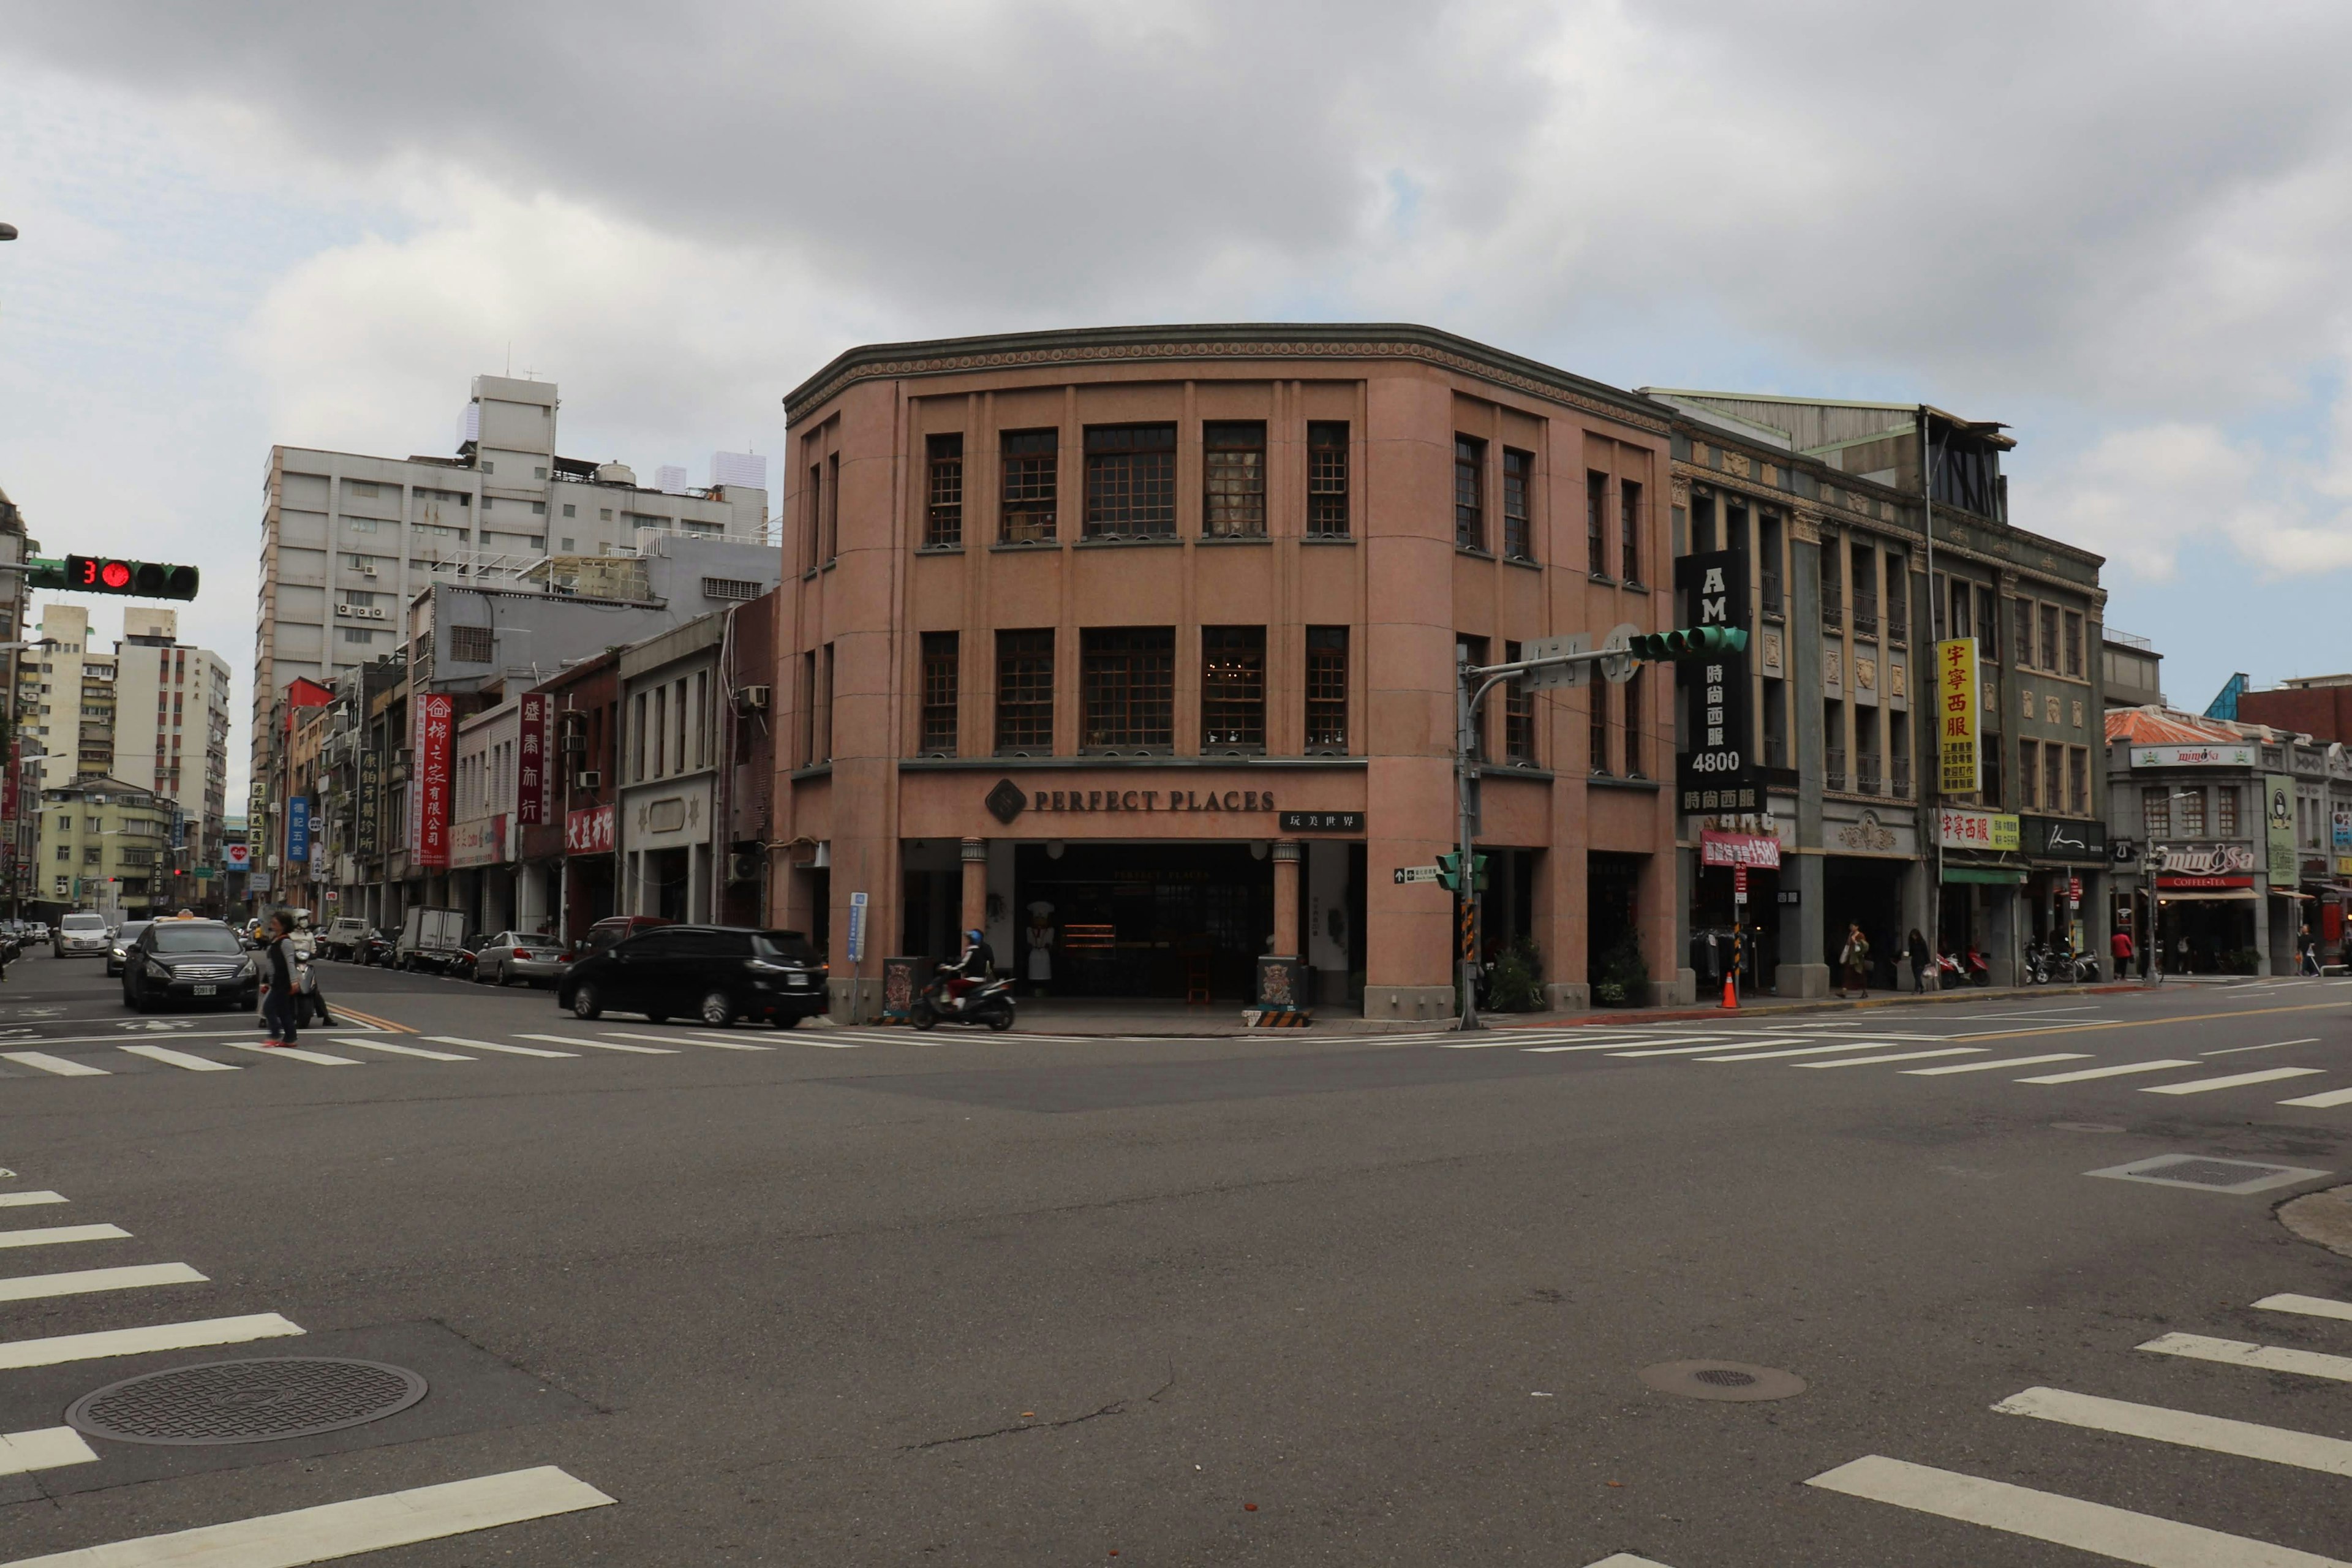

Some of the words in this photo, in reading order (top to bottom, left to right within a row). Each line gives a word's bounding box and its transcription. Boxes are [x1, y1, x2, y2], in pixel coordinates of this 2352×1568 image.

[84, 560, 96, 584] 3
[1706, 665, 1724, 746] 時尚西服
[1692, 751, 1740, 772] 4800
[426, 720, 447, 846] 棉之家有限公司
[360, 753, 377, 851] 康鉑牙醫診所
[1035, 791, 1158, 811] PERFECT
[1170, 791, 1275, 812] PLACES
[1684, 789, 1755, 809] 時尚西服
[292, 803, 304, 855] 德記五金
[1289, 815, 1354, 827] 玩美世界
